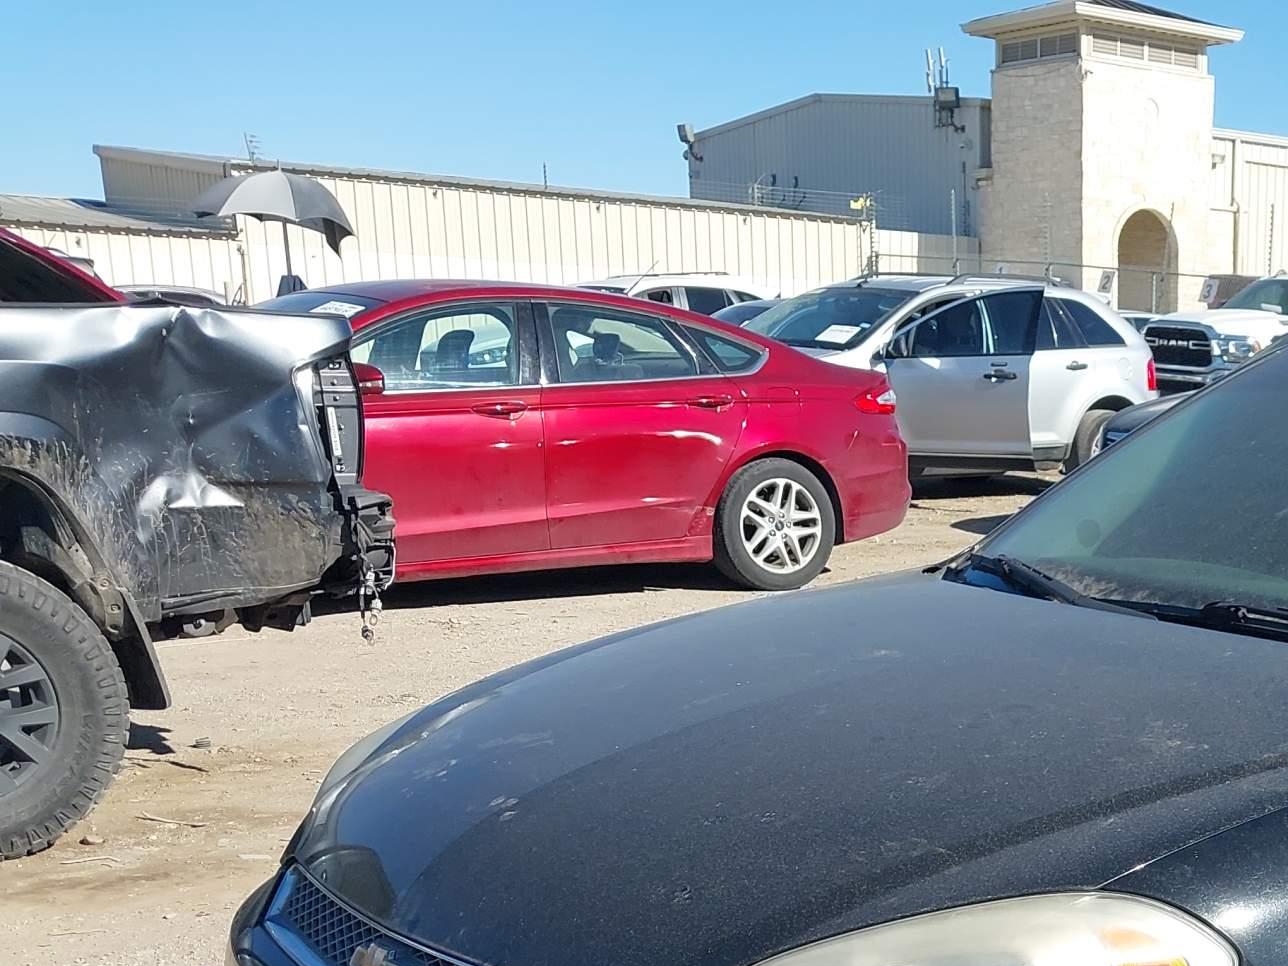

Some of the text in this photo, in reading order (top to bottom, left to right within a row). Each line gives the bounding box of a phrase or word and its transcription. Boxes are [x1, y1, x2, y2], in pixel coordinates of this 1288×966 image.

[1102, 275, 1110, 290] 2
[1203, 284, 1212, 298] 3
[1159, 338, 1188, 347] RAM
